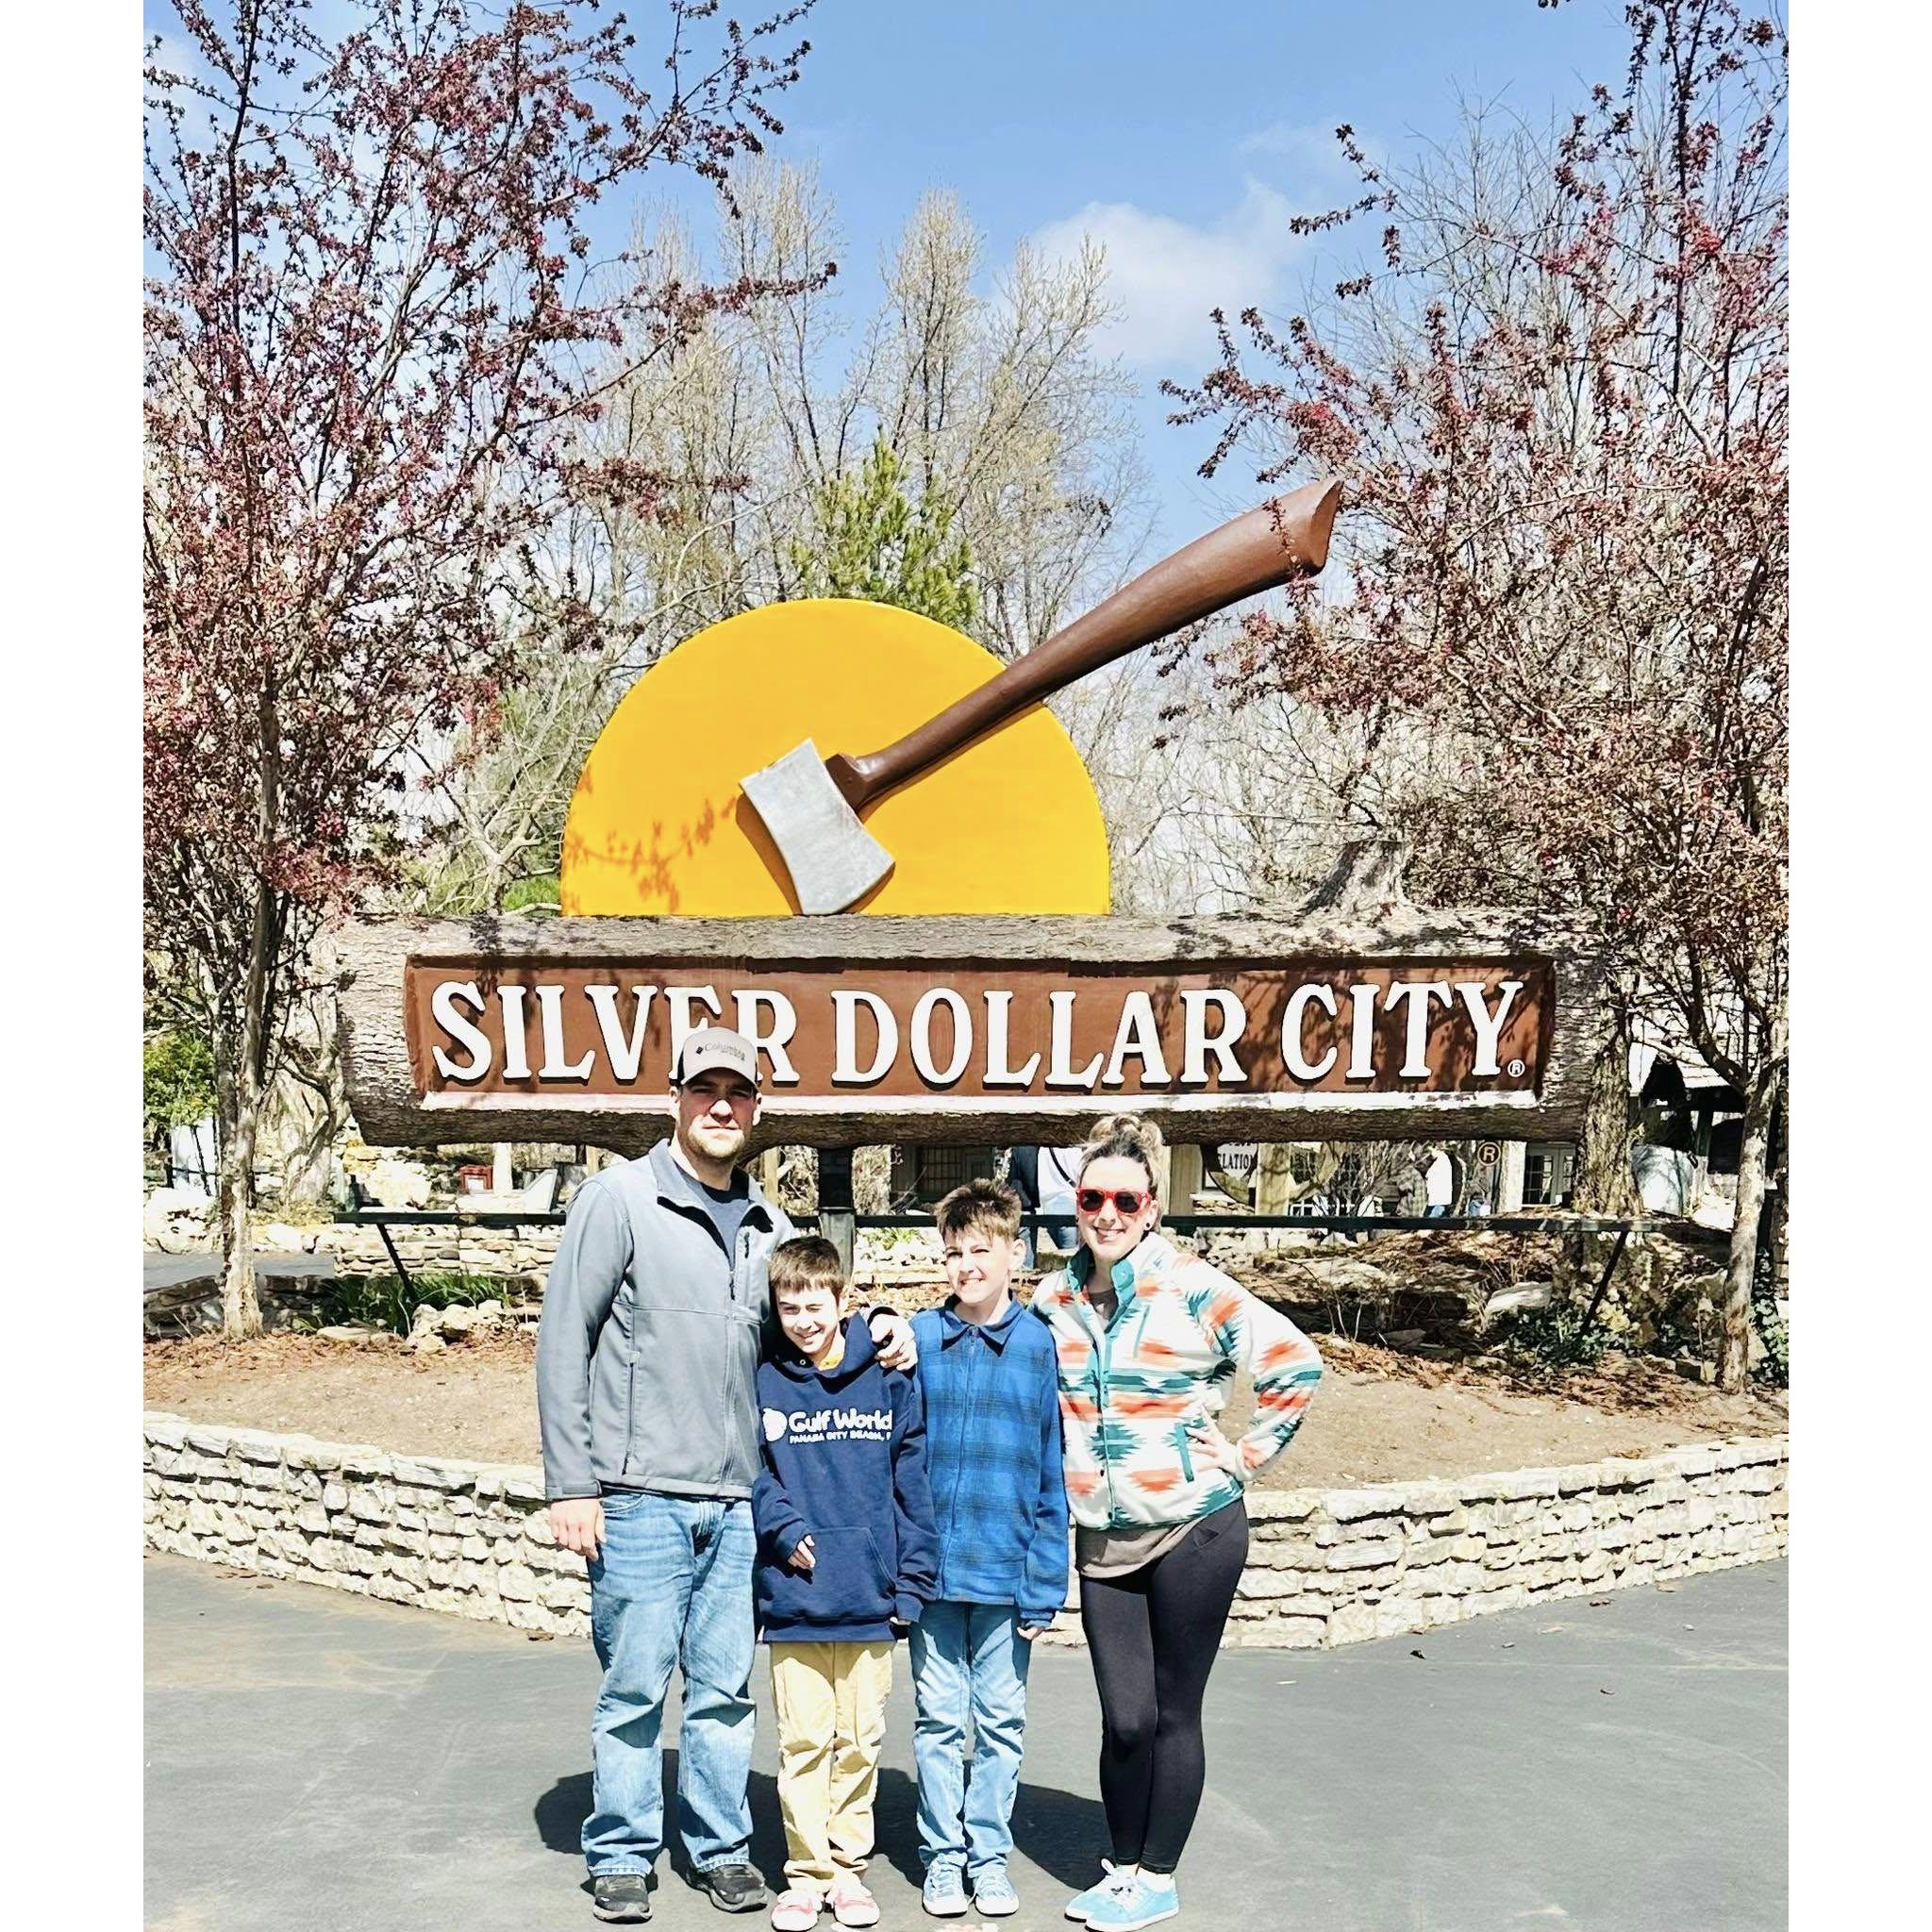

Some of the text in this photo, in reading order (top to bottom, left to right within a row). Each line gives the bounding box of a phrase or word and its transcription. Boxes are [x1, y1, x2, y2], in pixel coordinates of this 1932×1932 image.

[432, 981, 800, 1083] SILVER
[831, 988, 1248, 1088] DOLLAR
[789, 1408, 892, 1433] Gulf World
